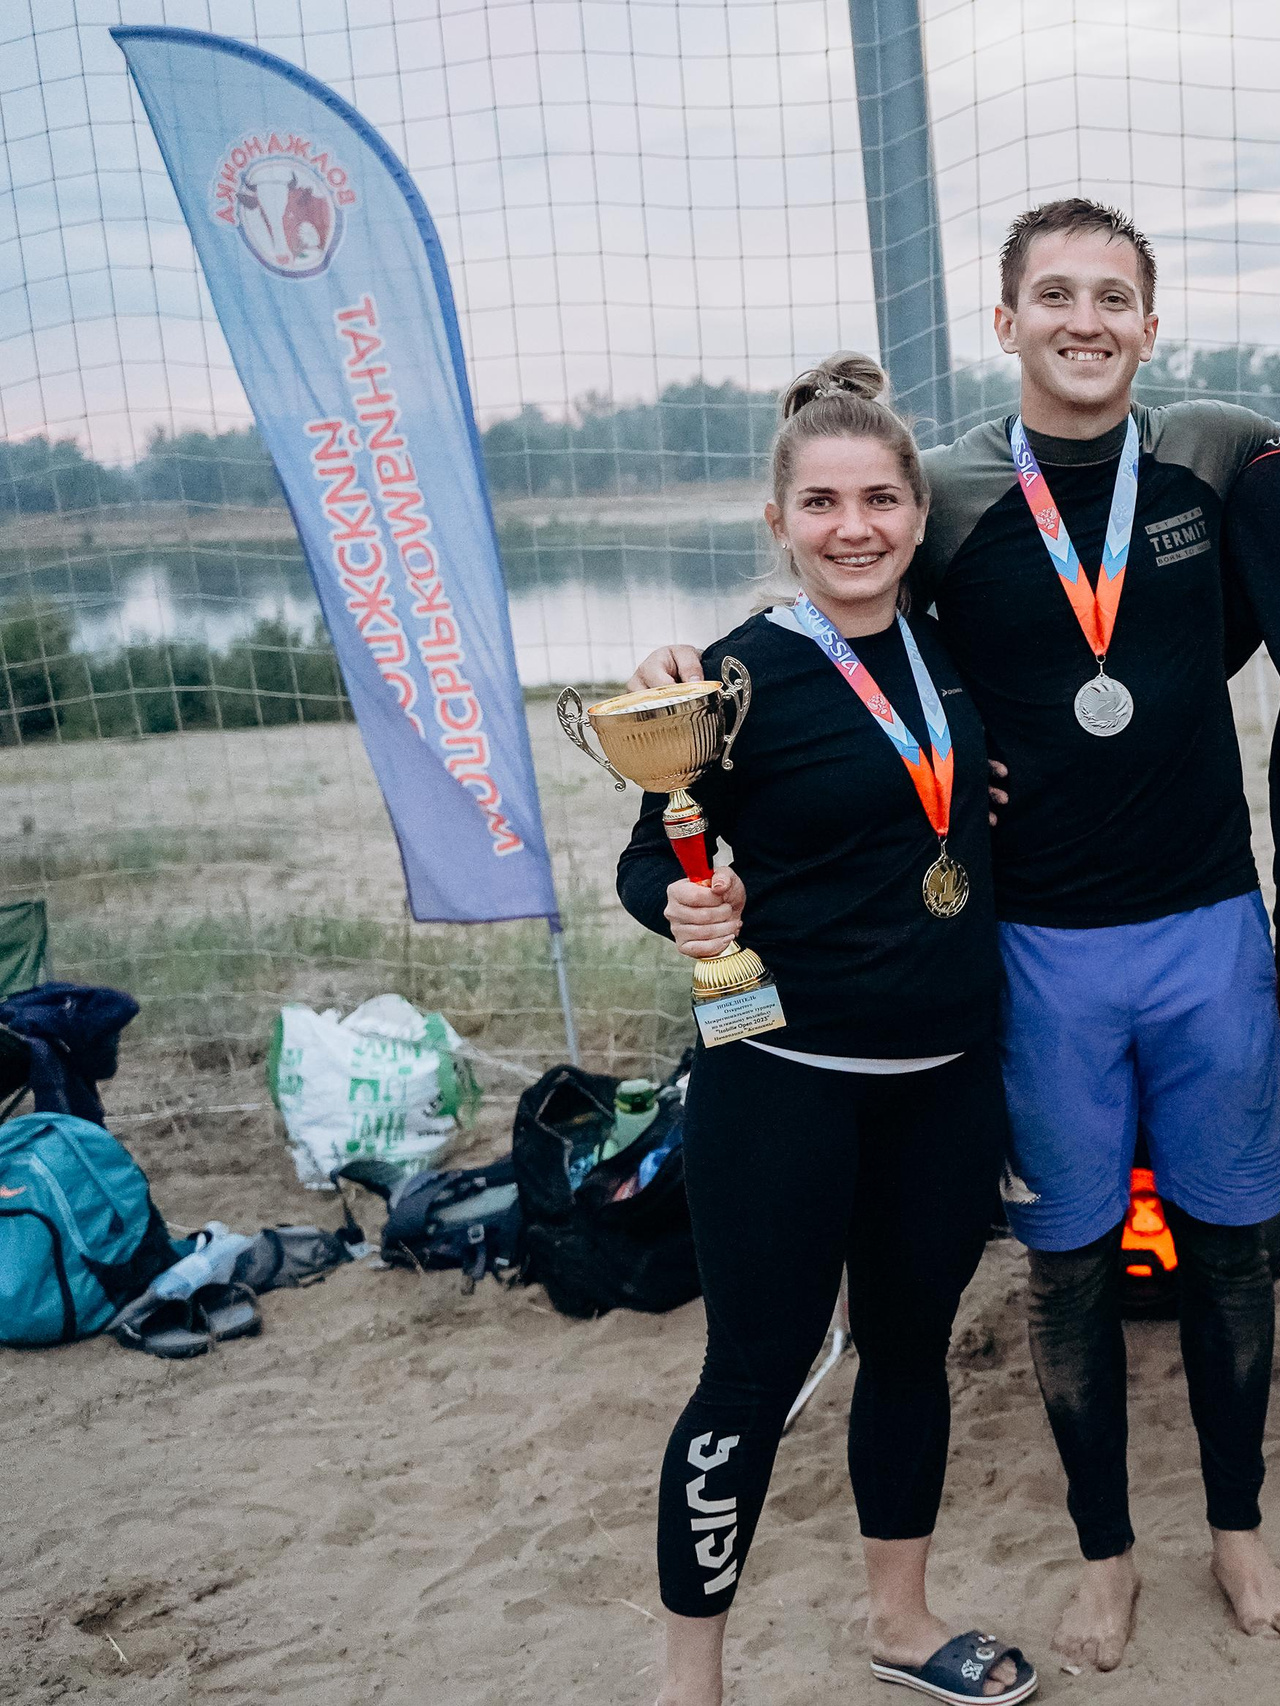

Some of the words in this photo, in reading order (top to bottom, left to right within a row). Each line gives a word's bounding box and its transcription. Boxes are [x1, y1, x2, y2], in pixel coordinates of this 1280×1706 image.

[1014, 439, 1039, 487] SSIA
[1150, 521, 1207, 552] TERMIT
[1158, 553, 1181, 564] BORN
[805, 603, 859, 676] RUSSIA
[738, 1020, 752, 1029] Open
